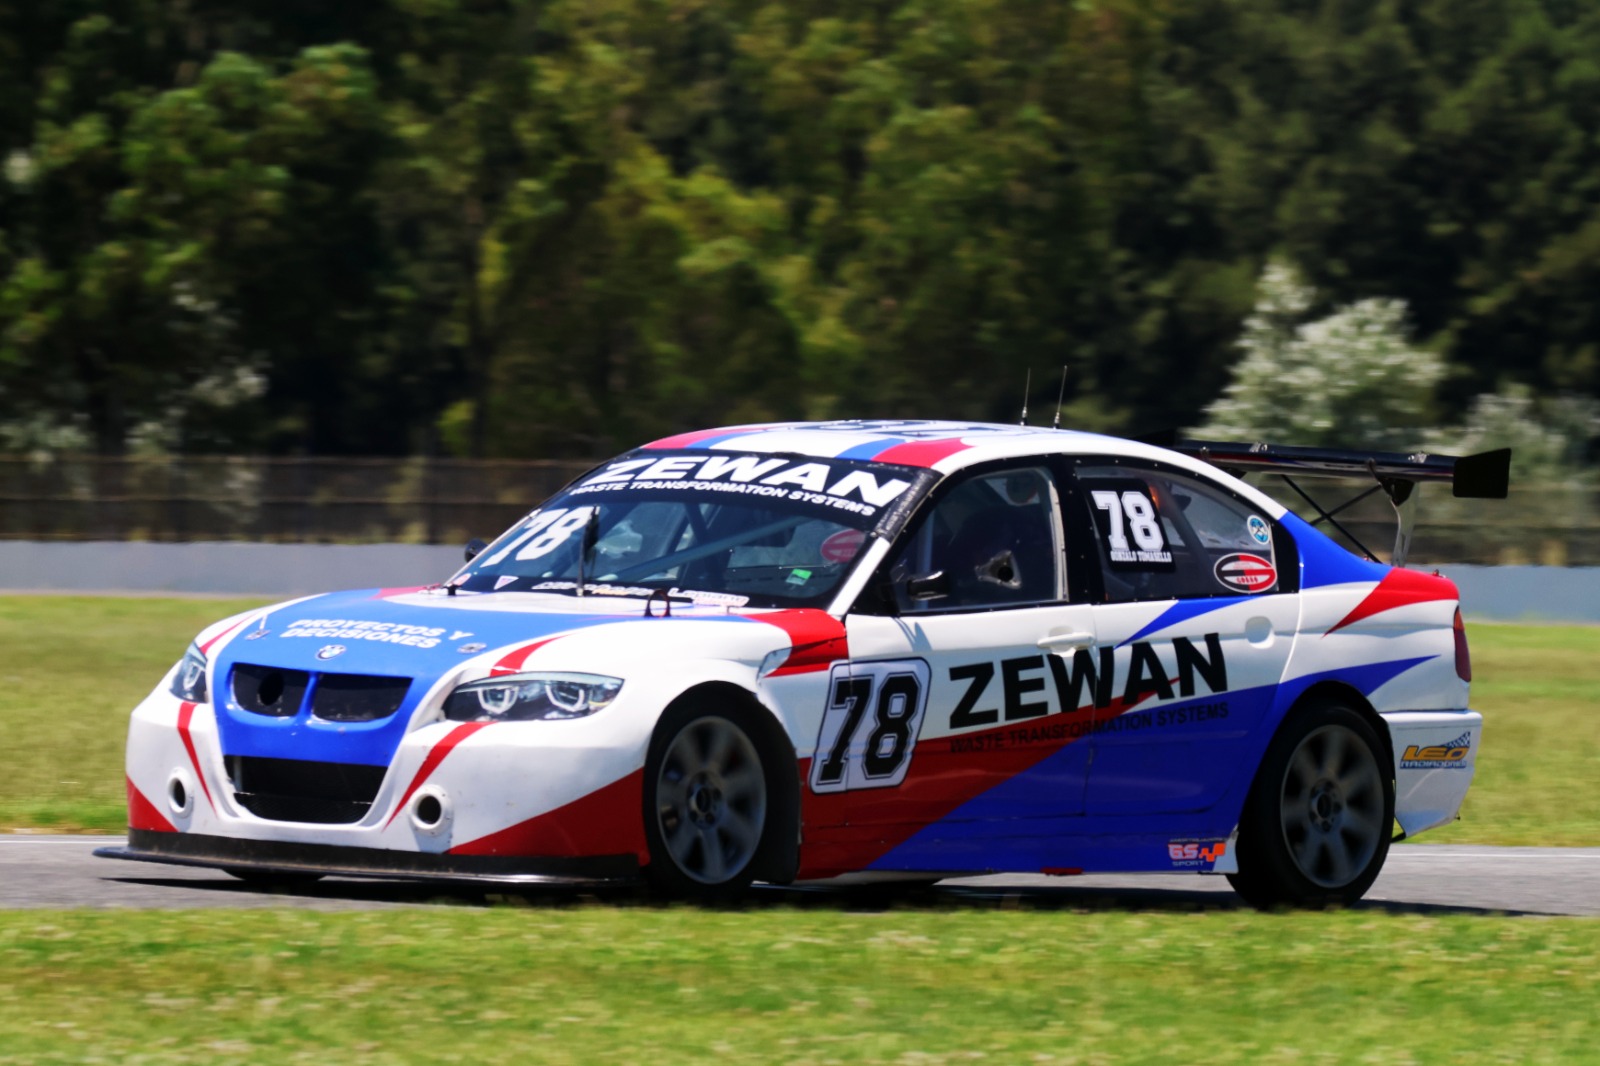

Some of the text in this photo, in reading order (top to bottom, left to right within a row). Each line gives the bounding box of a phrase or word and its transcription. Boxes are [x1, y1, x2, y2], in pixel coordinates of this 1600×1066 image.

[570, 481, 876, 516] WASTE TRANSFORMATION SYSTEMS
[581, 456, 911, 507] ZEWAN
[480, 506, 600, 568] 78
[1091, 491, 1164, 550] 78
[280, 627, 441, 649] DECISIONES
[287, 619, 475, 641] PROYECTOS Y
[949, 633, 1228, 729] ZEWAN
[816, 671, 922, 786] 78
[951, 702, 1229, 753] WASTE TRANSFORMATION SYSTEMS
[1402, 745, 1470, 761] LEO
